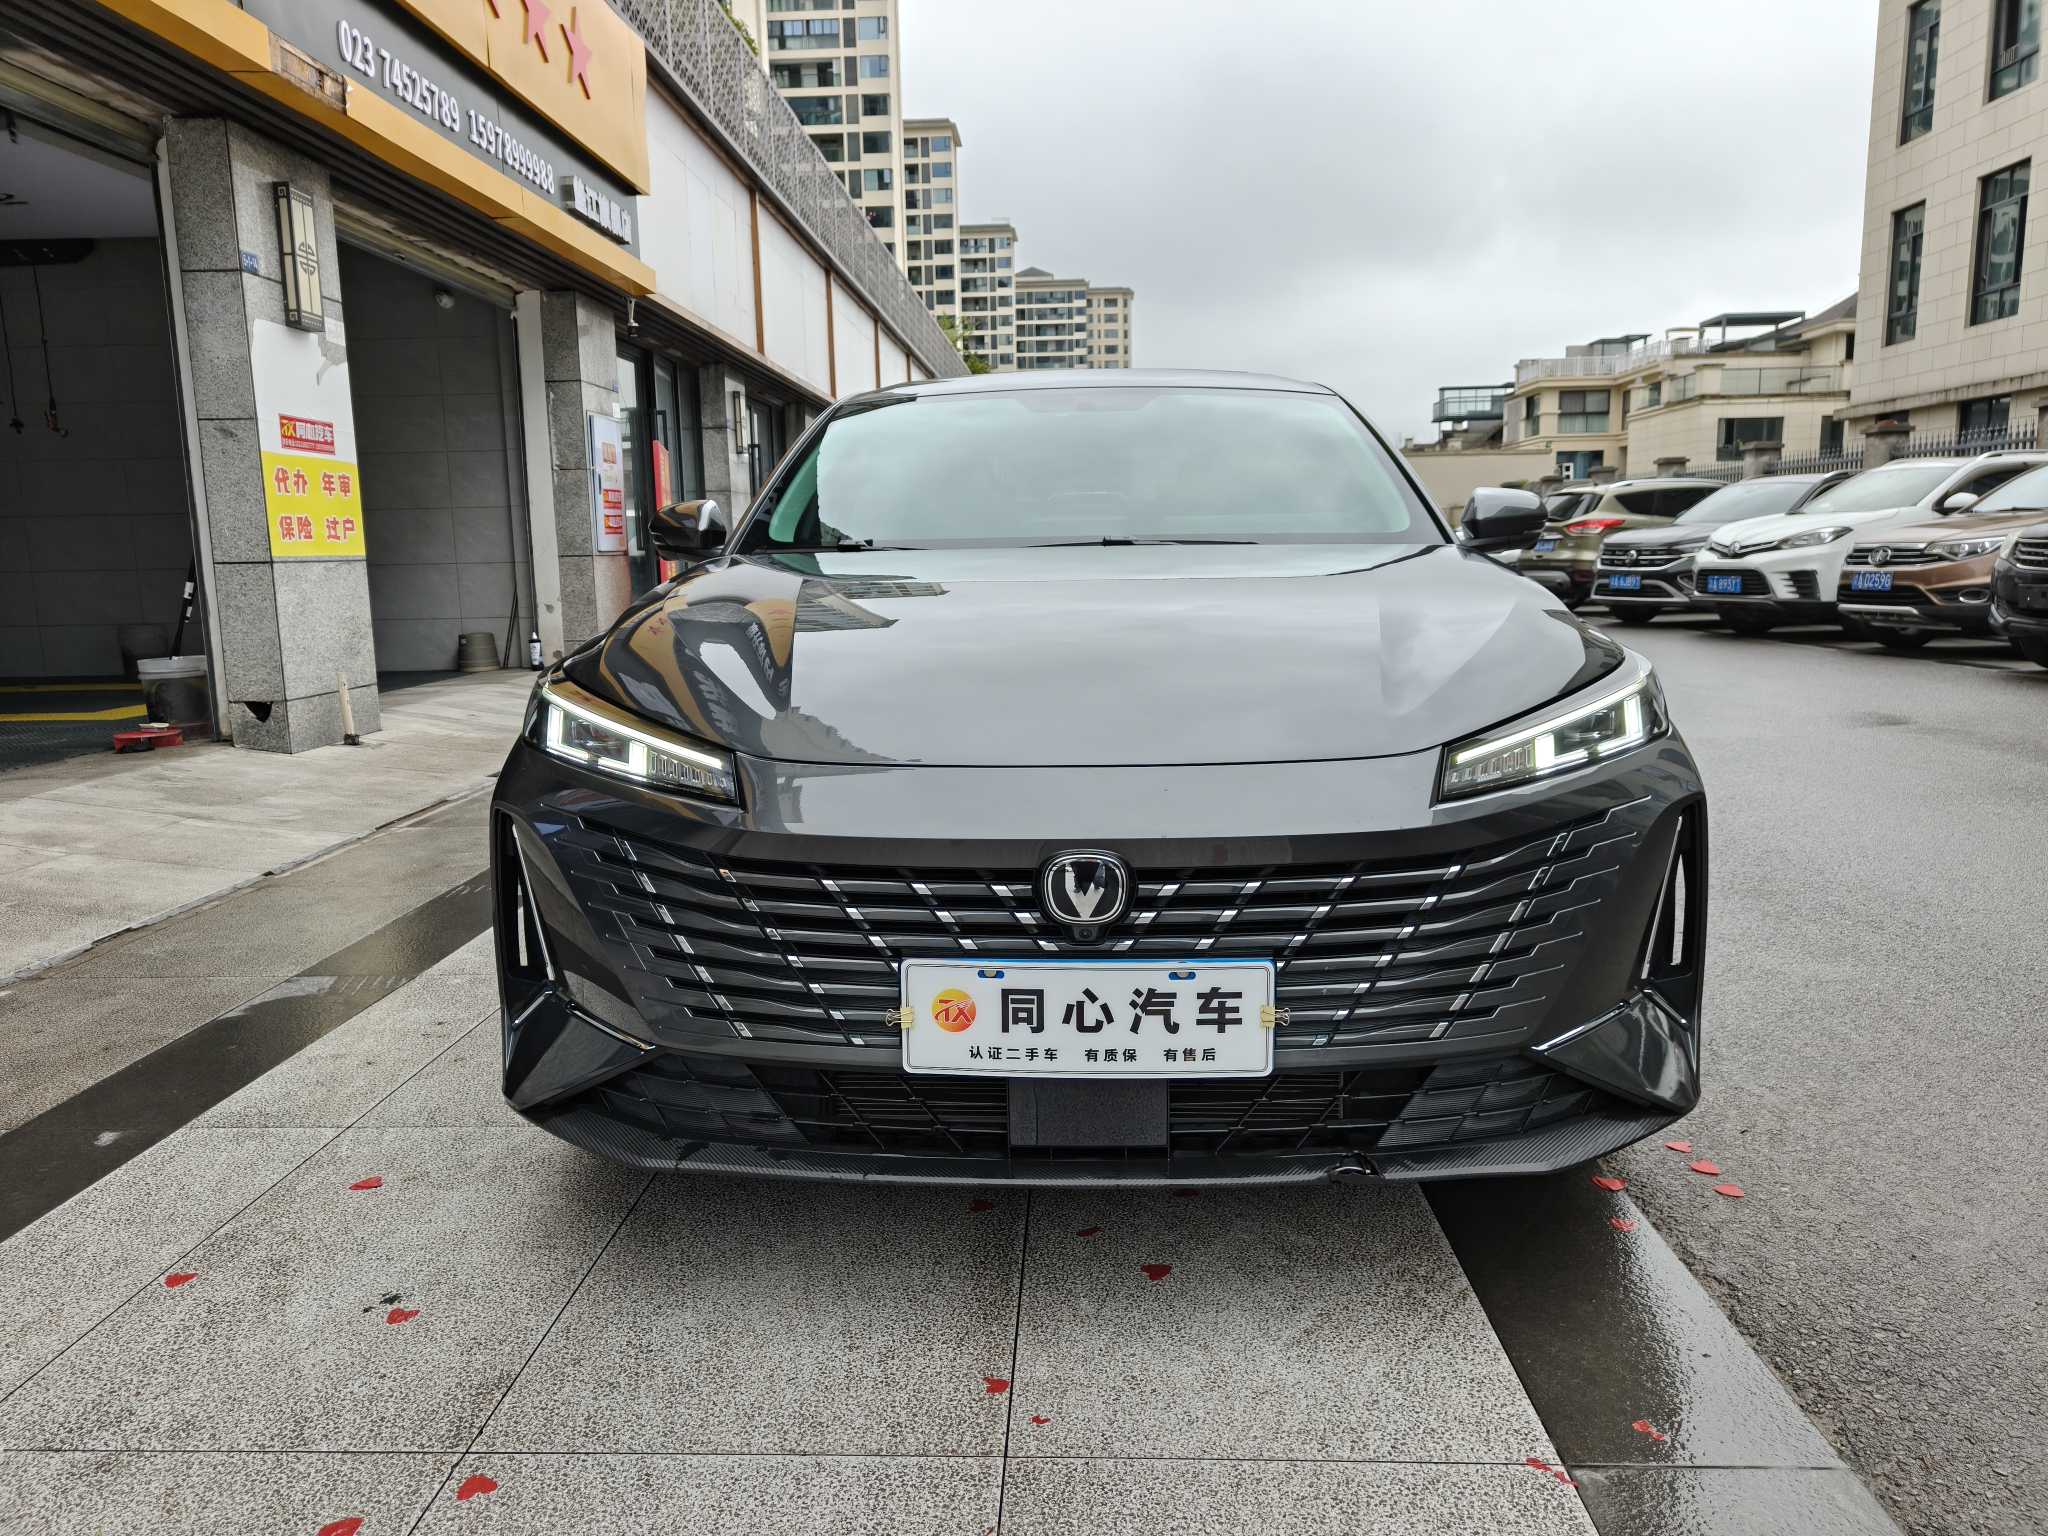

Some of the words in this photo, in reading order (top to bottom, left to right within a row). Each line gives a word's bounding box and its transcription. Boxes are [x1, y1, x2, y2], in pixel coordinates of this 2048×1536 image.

[338, 20, 375, 78] 023
[378, 48, 460, 132] 74525789
[467, 109, 555, 194] 15978999988
[274, 467, 308, 495] 代办
[322, 472, 351, 497] 年审
[279, 515, 312, 540] 保险
[326, 517, 355, 541] 过户
[1001, 987, 1243, 1034] 同心汽车
[968, 1046, 1058, 1062] 认证二手车
[1084, 1047, 1138, 1063] 有质保
[1163, 1047, 1217, 1063] 有售后
